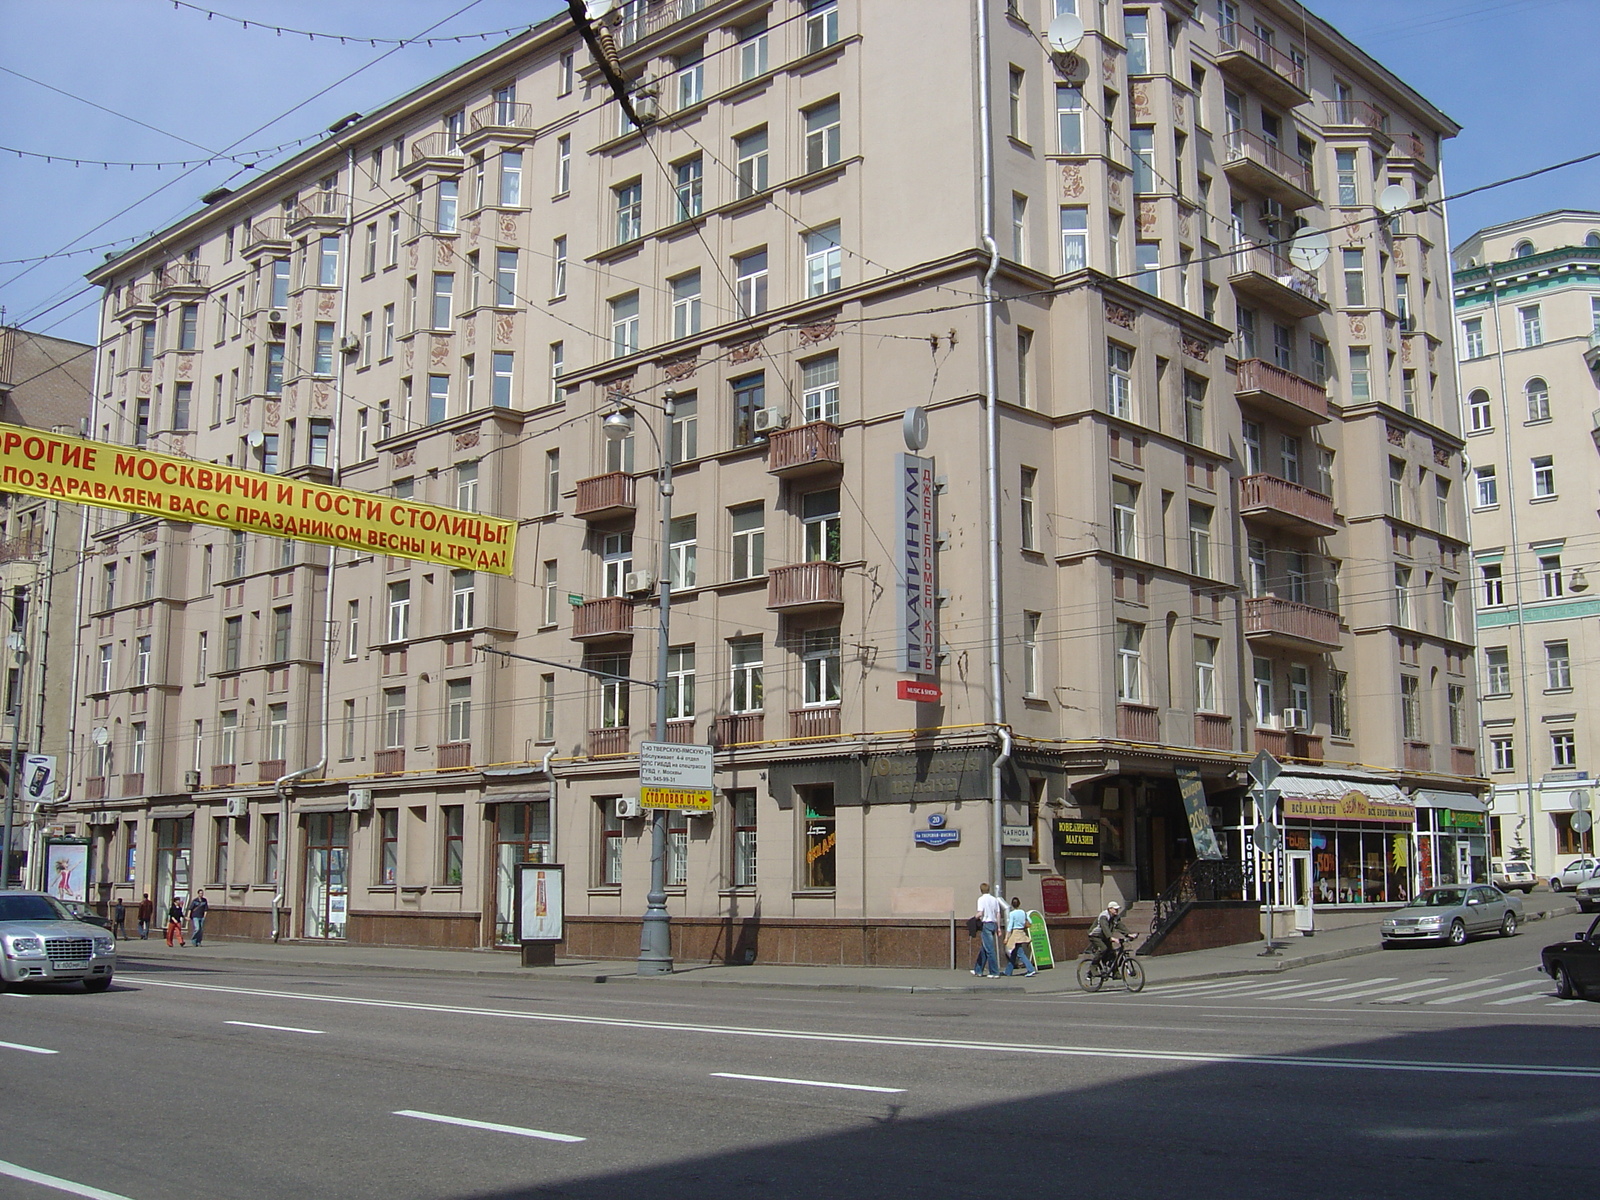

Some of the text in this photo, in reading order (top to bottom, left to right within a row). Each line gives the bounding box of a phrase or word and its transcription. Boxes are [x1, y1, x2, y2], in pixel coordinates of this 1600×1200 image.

[0, 431, 508, 545] РОГИЕ МОСКВИЧИ И ГОСТИ СТОЛИЦЫ!
[3, 465, 507, 569] ПОЗДРАВЛЯЕМ ВАС С ПРАЗДНИКОМ ВЕСНЫ И ТРУДА!
[906, 467, 921, 669] ПЛАТИНУМ
[922, 469, 933, 671] ДЖЕНТЕЛЬМЕН КЛУБ
[645, 792, 695, 805] СТОЛОВАЯ 01
[1291, 802, 1303, 813] ВСЁ
[1304, 803, 1317, 814] ДЛЯ
[1318, 803, 1337, 815] ДЕТЕЙ
[932, 816, 941, 824] 20
[1189, 806, 1210, 831] 20%
[1003, 829, 1029, 837] ЧАЯНОВА
[1058, 821, 1099, 833] ЮВЕЛИРНЫЙ
[1065, 834, 1094, 845] МАГАЗИН
